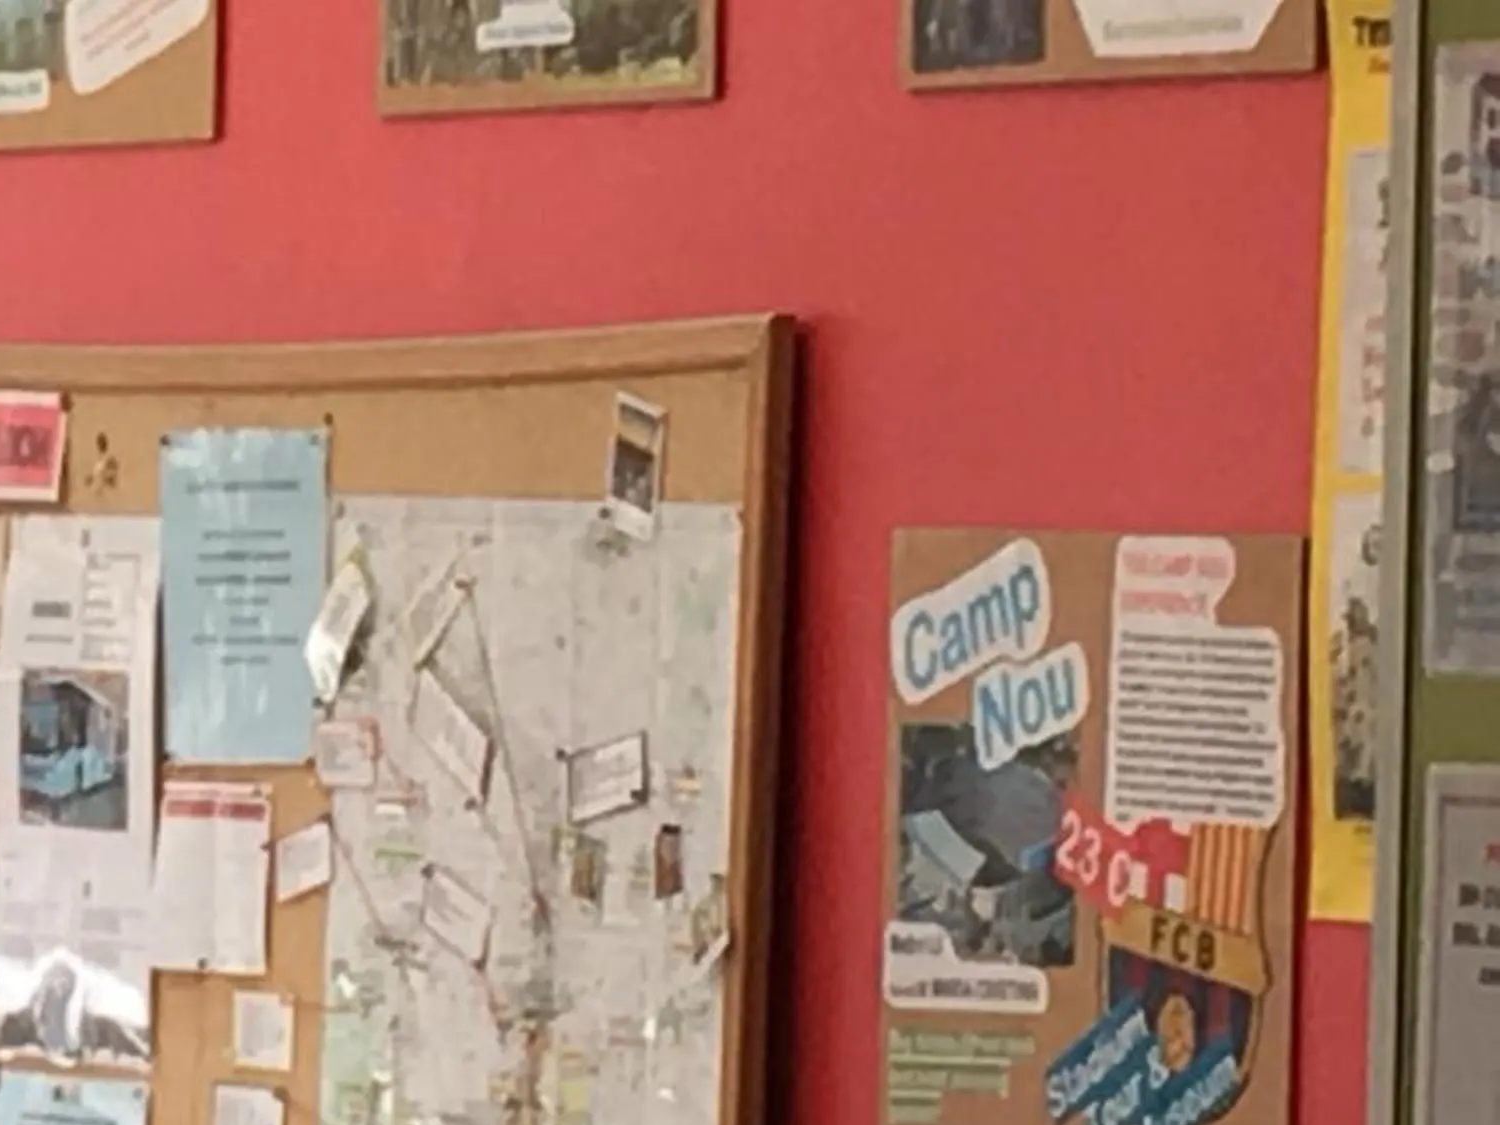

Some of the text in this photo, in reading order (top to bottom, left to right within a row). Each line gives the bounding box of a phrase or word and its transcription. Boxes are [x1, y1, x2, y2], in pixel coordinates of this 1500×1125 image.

[904, 562, 1040, 690] Camp
[978, 657, 1075, 760] Nou
[1056, 808, 1102, 886] 23
[1152, 914, 1217, 972] FCB
